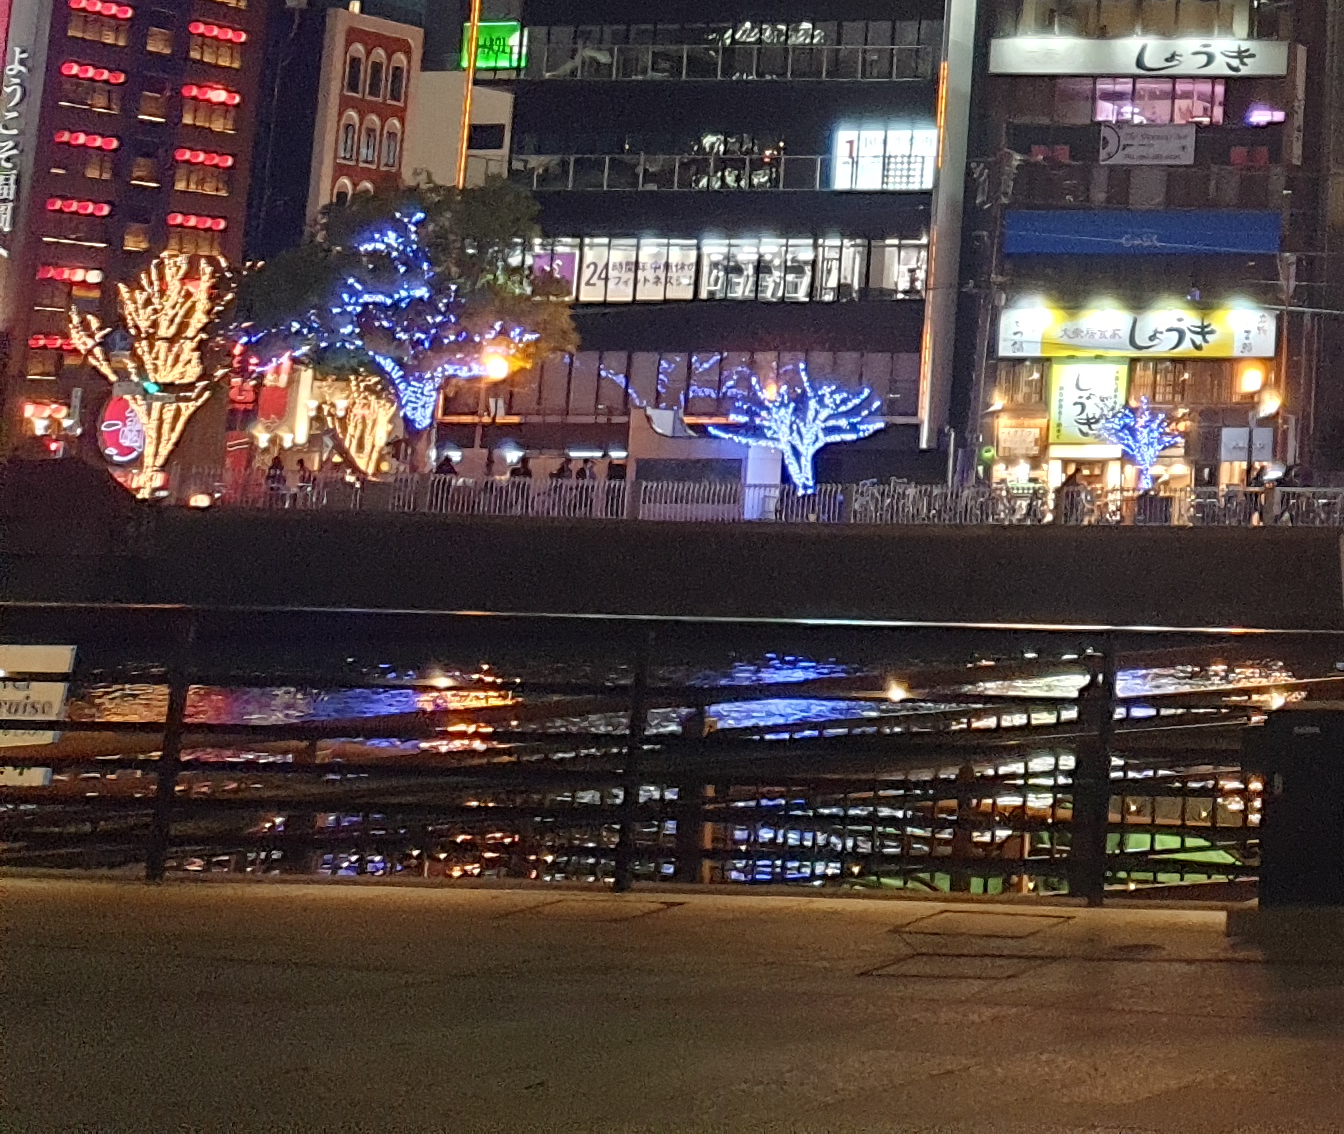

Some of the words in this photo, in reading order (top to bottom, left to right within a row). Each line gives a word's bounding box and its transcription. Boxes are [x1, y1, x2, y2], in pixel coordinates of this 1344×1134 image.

[1134, 42, 1257, 73] しょうき
[584, 261, 610, 287] 24
[1128, 316, 1217, 352] しょうき
